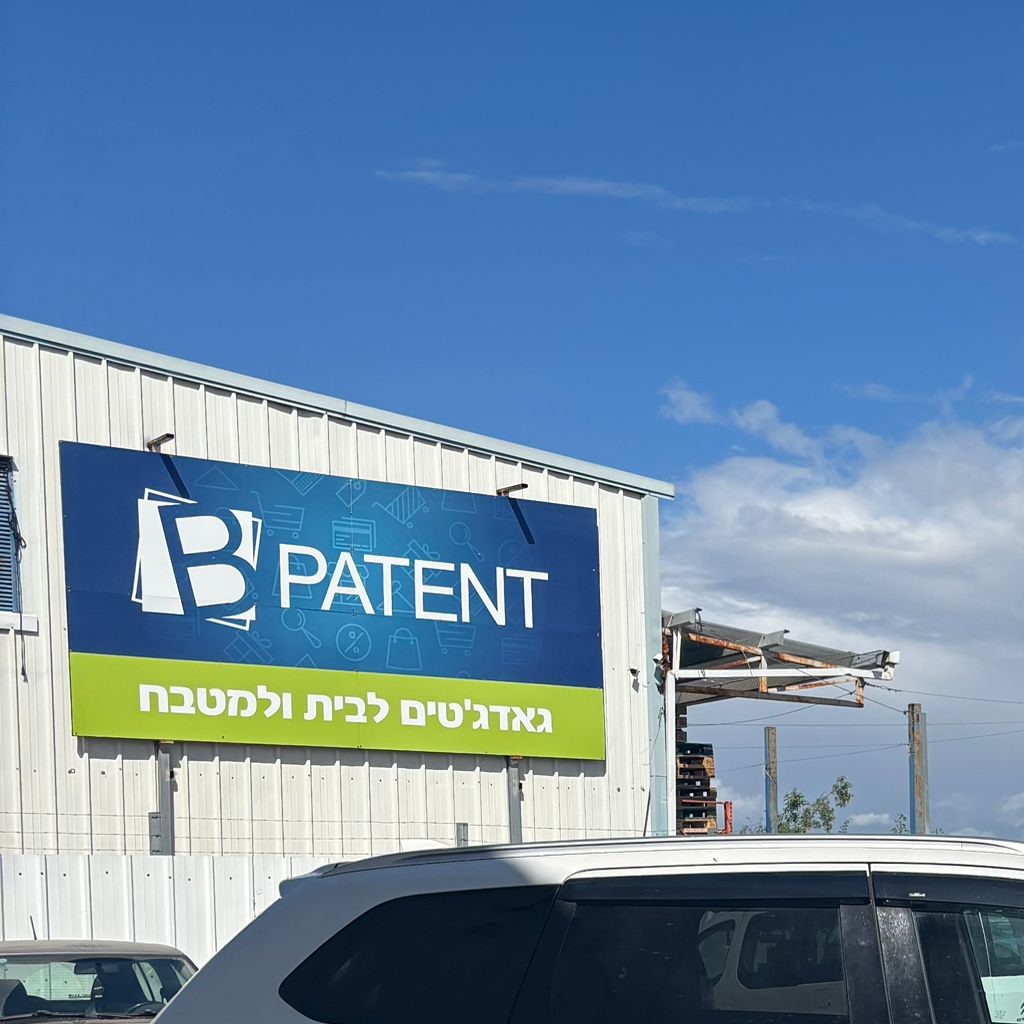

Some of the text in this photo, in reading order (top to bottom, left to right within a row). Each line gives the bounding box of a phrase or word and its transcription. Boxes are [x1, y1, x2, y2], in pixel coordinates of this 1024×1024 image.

[134, 490, 549, 630] B PATENT
[138, 683, 553, 734] גאדג'טים לבית ולמטבח
